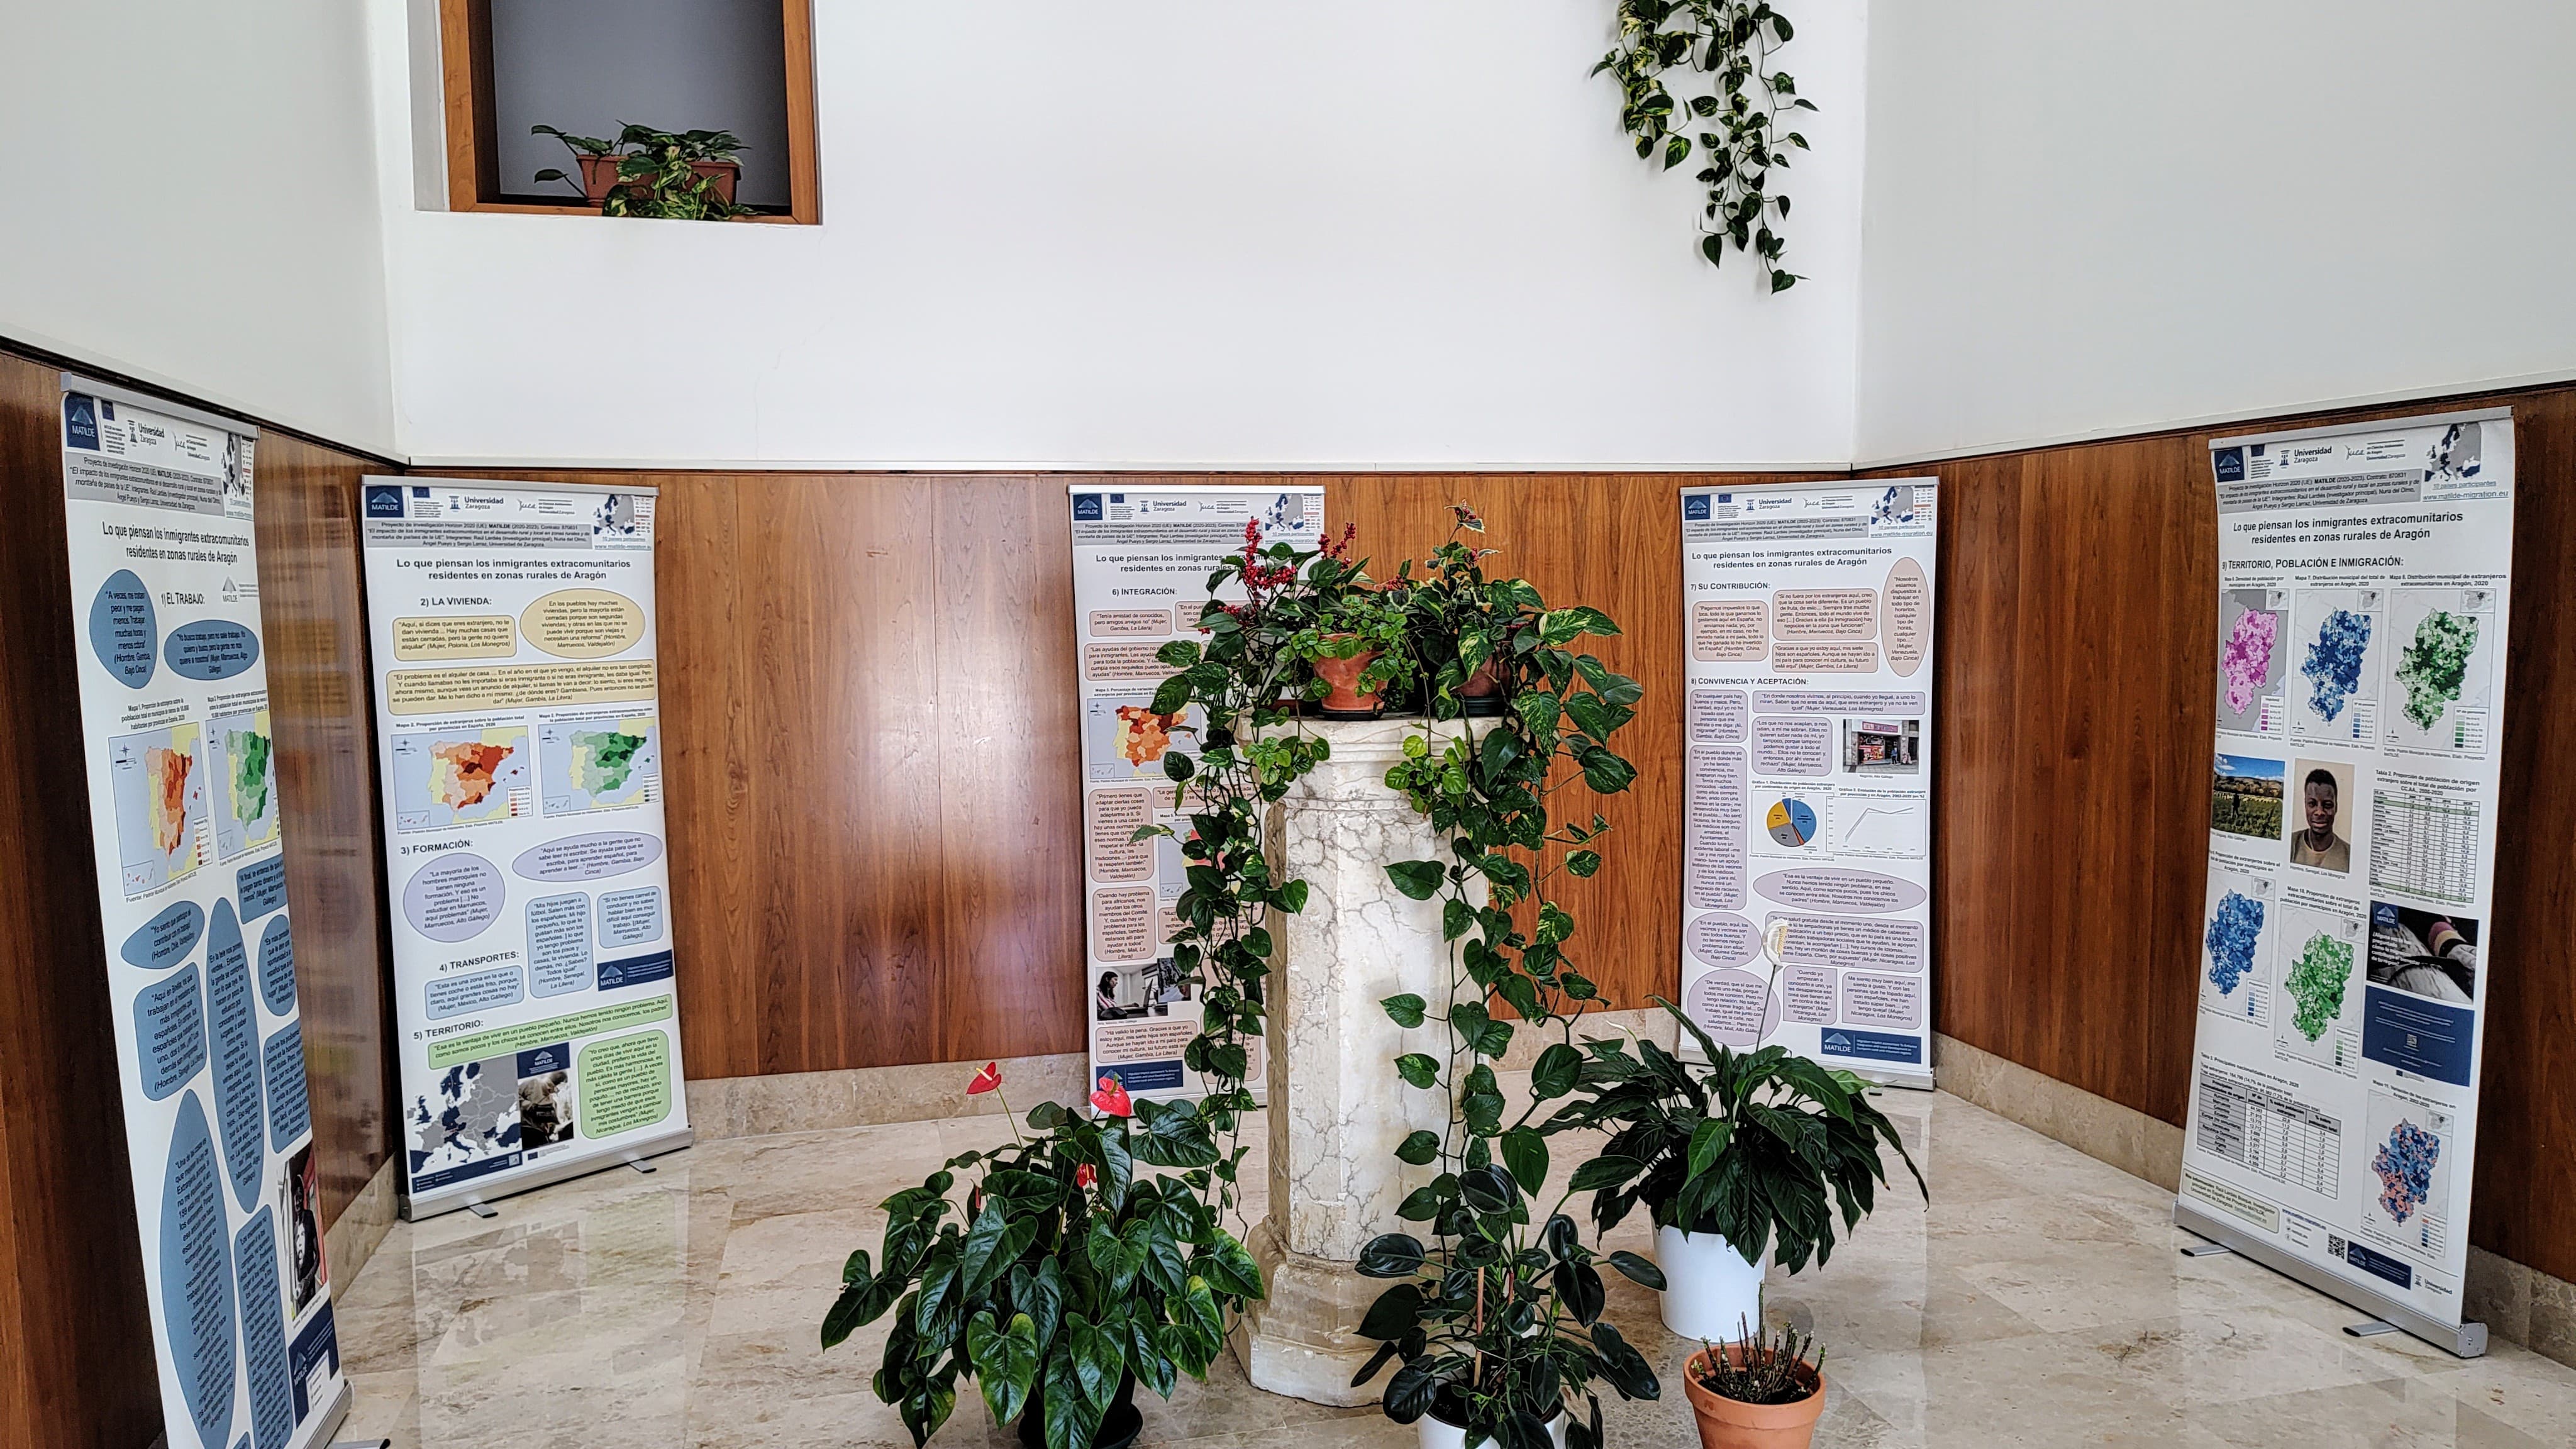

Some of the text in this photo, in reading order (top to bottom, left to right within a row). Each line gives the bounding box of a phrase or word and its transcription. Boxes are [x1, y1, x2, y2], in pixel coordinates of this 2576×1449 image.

[72, 426, 95, 437] MATILDE
[138, 423, 165, 437] Universidad
[2294, 447, 2332, 456] Universidad
[464, 496, 504, 505] Universidad
[2423, 491, 2509, 501] www.matilde-migration.eu
[2233, 512, 2463, 533] Lo que piensan los inmigrantes extracomunitarios
[103, 523, 248, 546] Lo que piensan los inmigrantes extracomunitarios
[2251, 535, 2296, 543] residentes
[2343, 531, 2377, 540] rurales
[2380, 530, 2391, 539] de
[2394, 528, 2429, 540] Aragón
[126, 546, 237, 565] residentes en zonas rurales de Aragón
[1816, 547, 1892, 555] extracomunitarios
[397, 559, 410, 567] Lo
[436, 558, 473, 569] piensan
[476, 558, 490, 567] los
[492, 559, 548, 569] inmigrantes
[1175, 554, 1223, 562] inmigrantes
[1837, 558, 1867, 566] Aragón
[2228, 560, 2273, 569] TERRITORIO,
[2275, 557, 2328, 569] POBLACIÓN
[2331, 558, 2336, 567] E
[2339, 556, 2403, 566] INMIGRACIÓN:
[428, 571, 478, 579] residentes
[574, 571, 606, 580] Aragón
[167, 592, 175, 604] EL
[175, 592, 204, 604] TRABAJO:
[420, 598, 429, 607] 2)
[401, 840, 472, 855] 3) FORMACIÓN:
[439, 952, 519, 972] 4) TRANSPORTES:
[600, 977, 623, 985] MATILDE
[414, 1020, 483, 1040] 5) TERRITORIO:
[1824, 1043, 1852, 1053] MATILDE
[535, 1057, 552, 1065] MATILDE
[2424, 1279, 2453, 1294] Universidad
